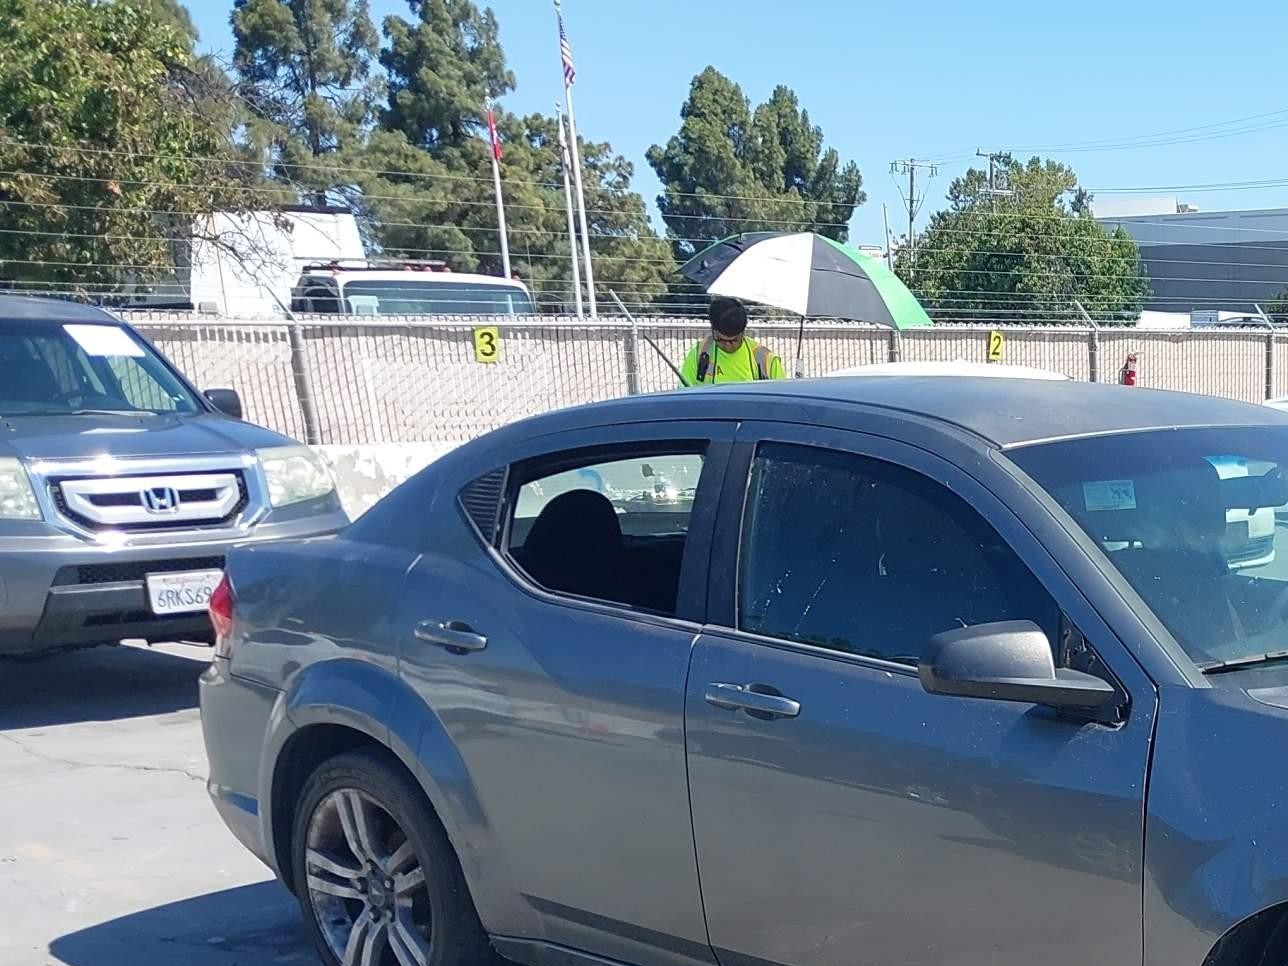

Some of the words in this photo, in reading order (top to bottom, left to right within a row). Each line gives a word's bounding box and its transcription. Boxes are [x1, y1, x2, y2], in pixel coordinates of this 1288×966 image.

[480, 331, 496, 357] 3
[991, 335, 1002, 356] 2
[158, 586, 212, 609] 6RKS69
